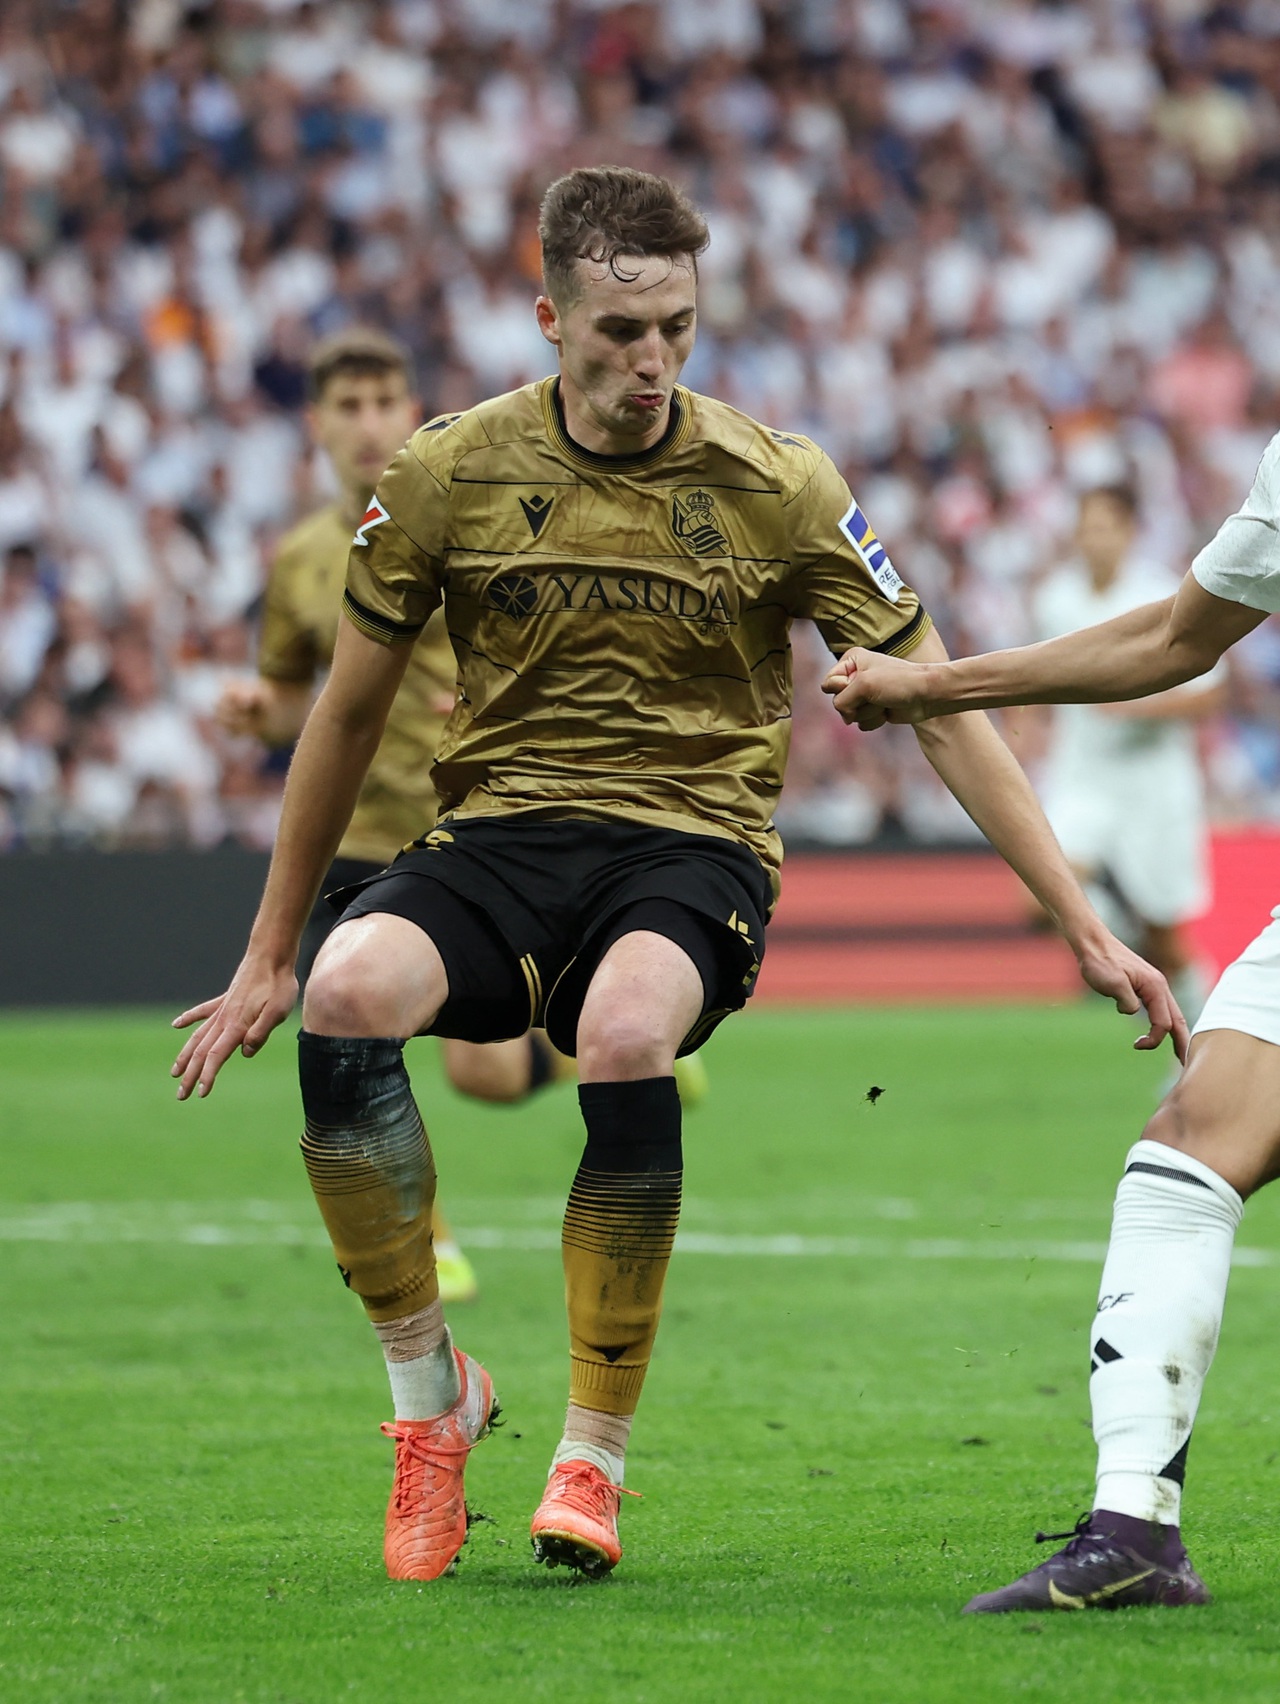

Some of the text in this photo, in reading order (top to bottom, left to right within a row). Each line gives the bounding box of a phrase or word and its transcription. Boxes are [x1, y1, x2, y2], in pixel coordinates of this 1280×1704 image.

[552, 575, 732, 621] YASUDA
[700, 623, 729, 636] grou
[1096, 1292, 1135, 1313] CF
